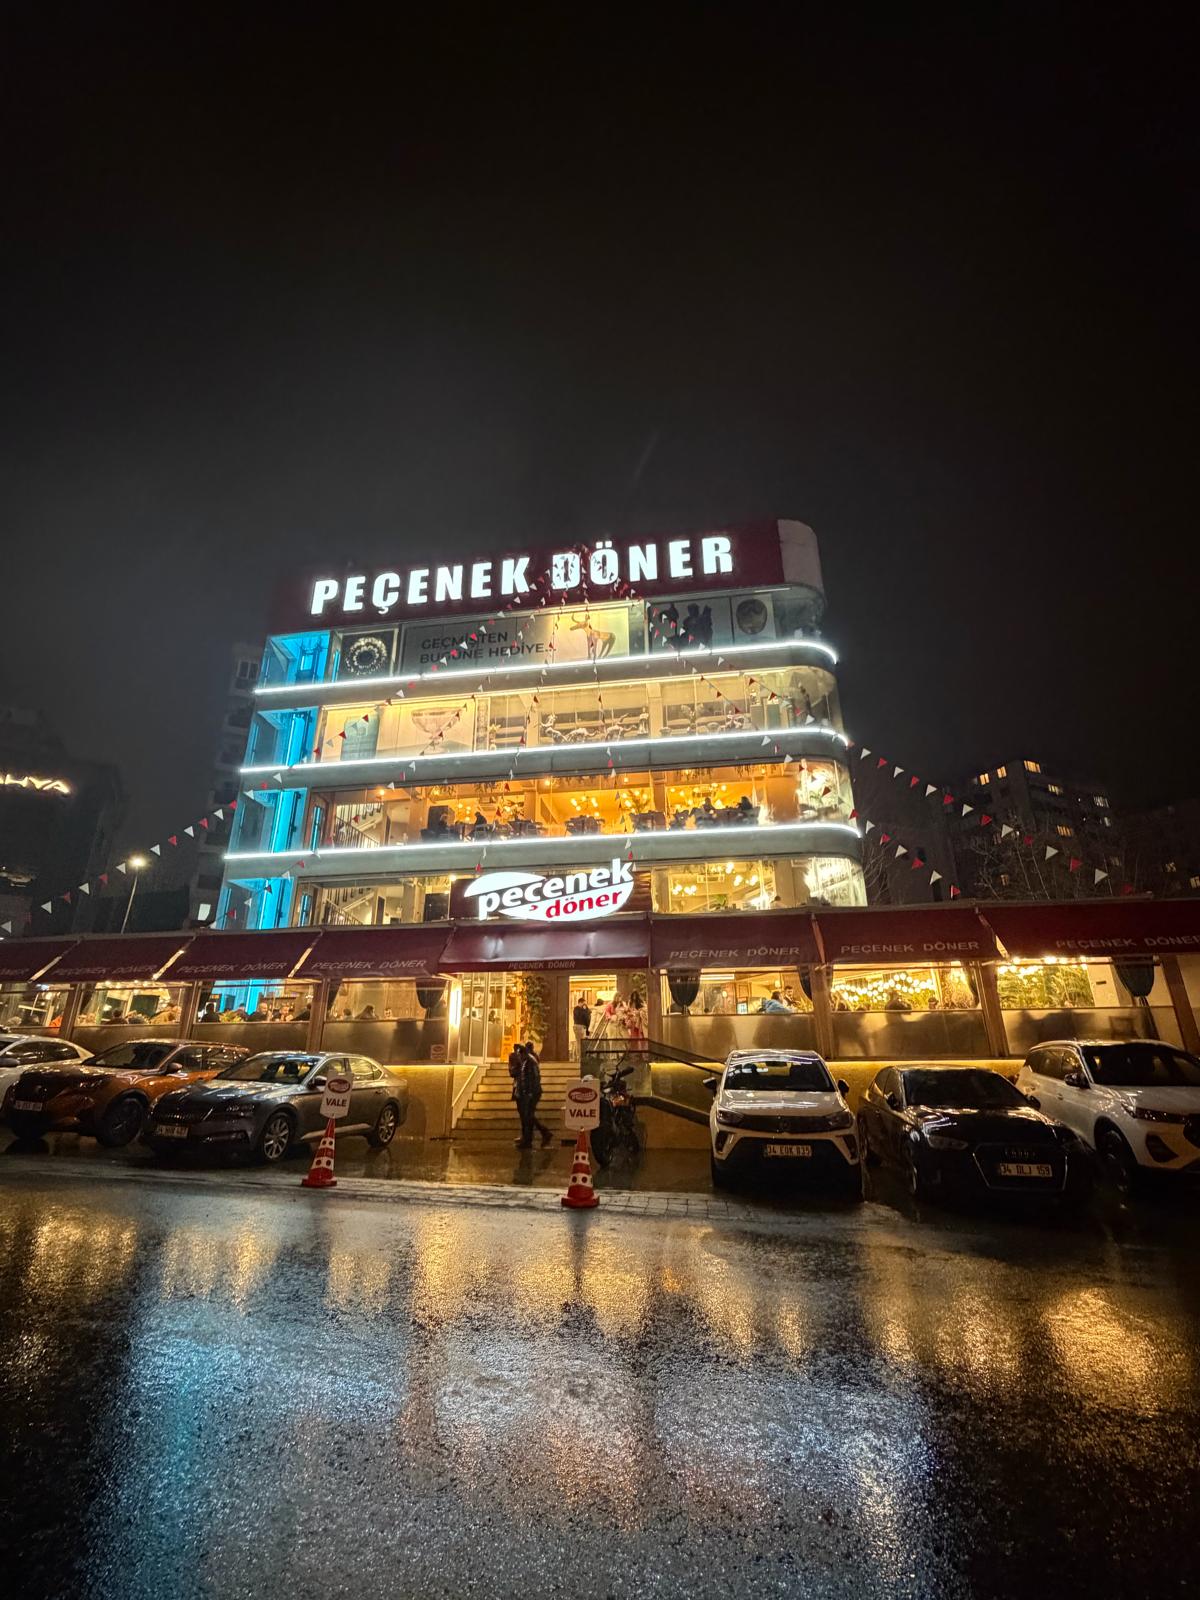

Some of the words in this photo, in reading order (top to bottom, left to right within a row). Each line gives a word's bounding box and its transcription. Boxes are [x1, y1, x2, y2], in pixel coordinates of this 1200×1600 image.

[311, 557, 530, 615] PEÇENEK
[551, 536, 734, 590] DÖNER
[478, 857, 633, 921] peçenek
[545, 890, 622, 918] döner
[747, 945, 801, 957] DÖNER
[923, 941, 980, 951] DÖNER
[326, 1097, 347, 1107] VALE
[569, 1108, 597, 1118] VALE
